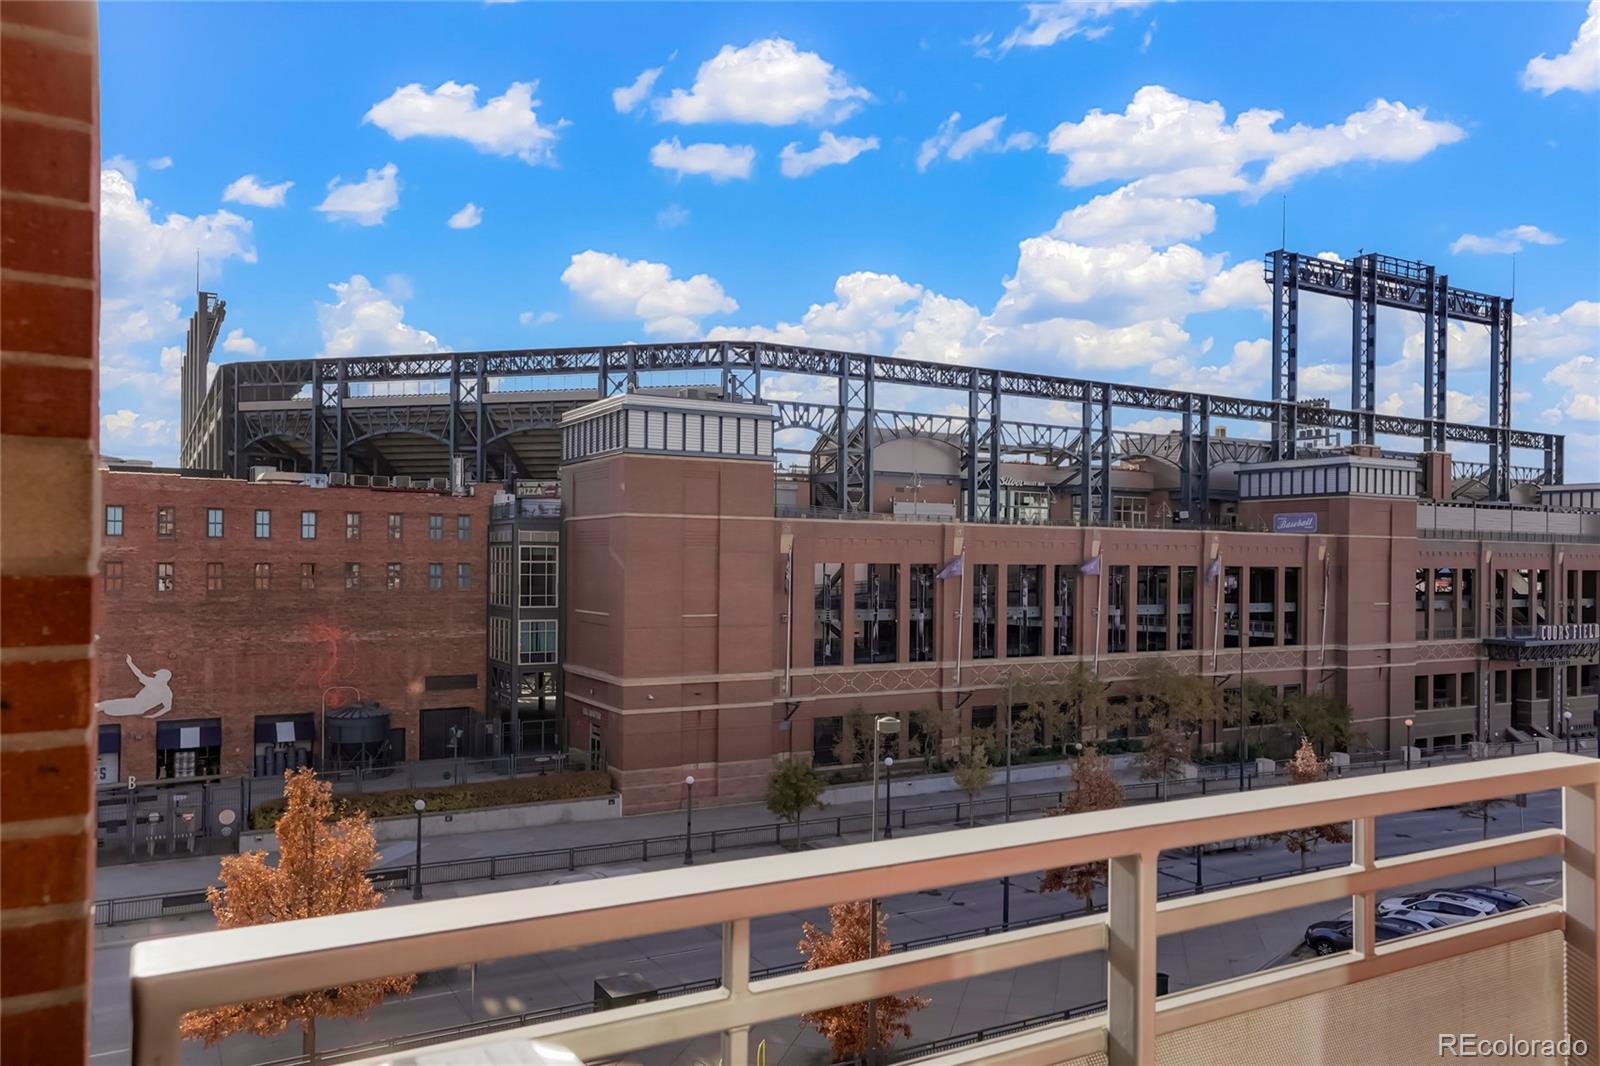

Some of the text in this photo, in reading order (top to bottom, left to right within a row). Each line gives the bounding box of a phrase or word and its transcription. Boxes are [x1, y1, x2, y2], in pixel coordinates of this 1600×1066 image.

[518, 487, 542, 496] PIZZA
[1541, 623, 1600, 641] COORS FIELD
[128, 775, 137, 790] B
